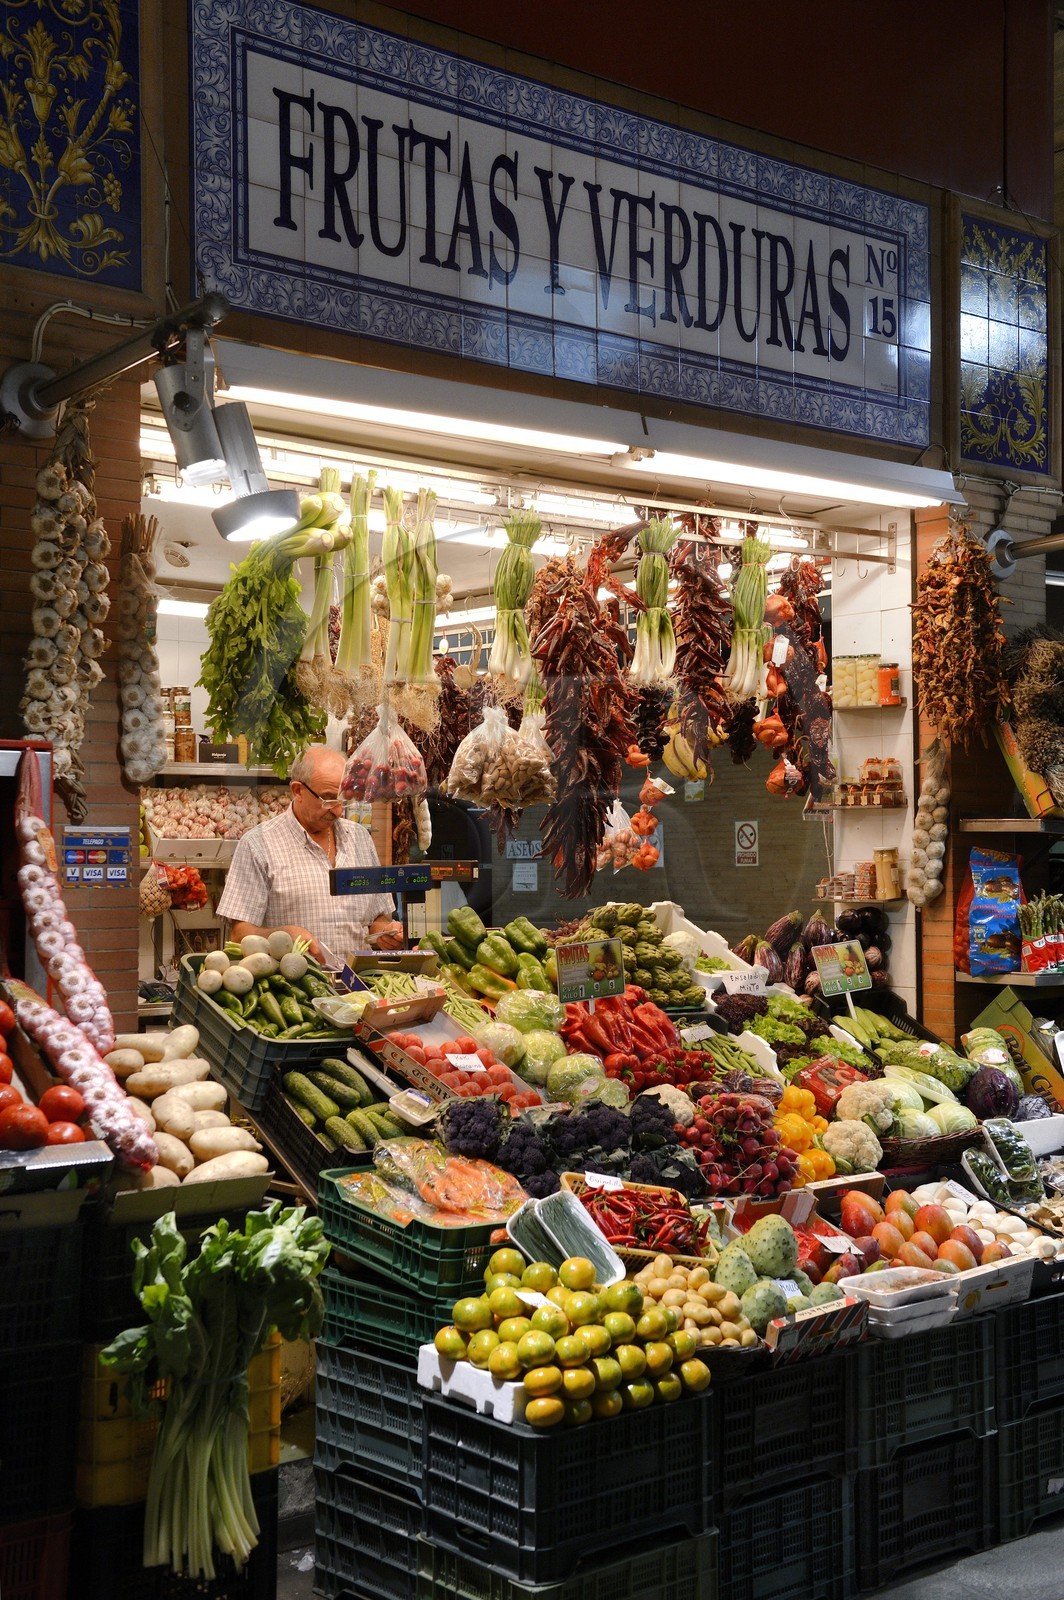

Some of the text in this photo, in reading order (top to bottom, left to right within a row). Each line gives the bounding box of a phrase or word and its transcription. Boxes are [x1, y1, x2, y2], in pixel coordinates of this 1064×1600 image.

[273, 88, 852, 362] FRUTAS Y VERDURAS
[869, 296, 897, 338] 15
[508, 842, 541, 857] ASEOS
